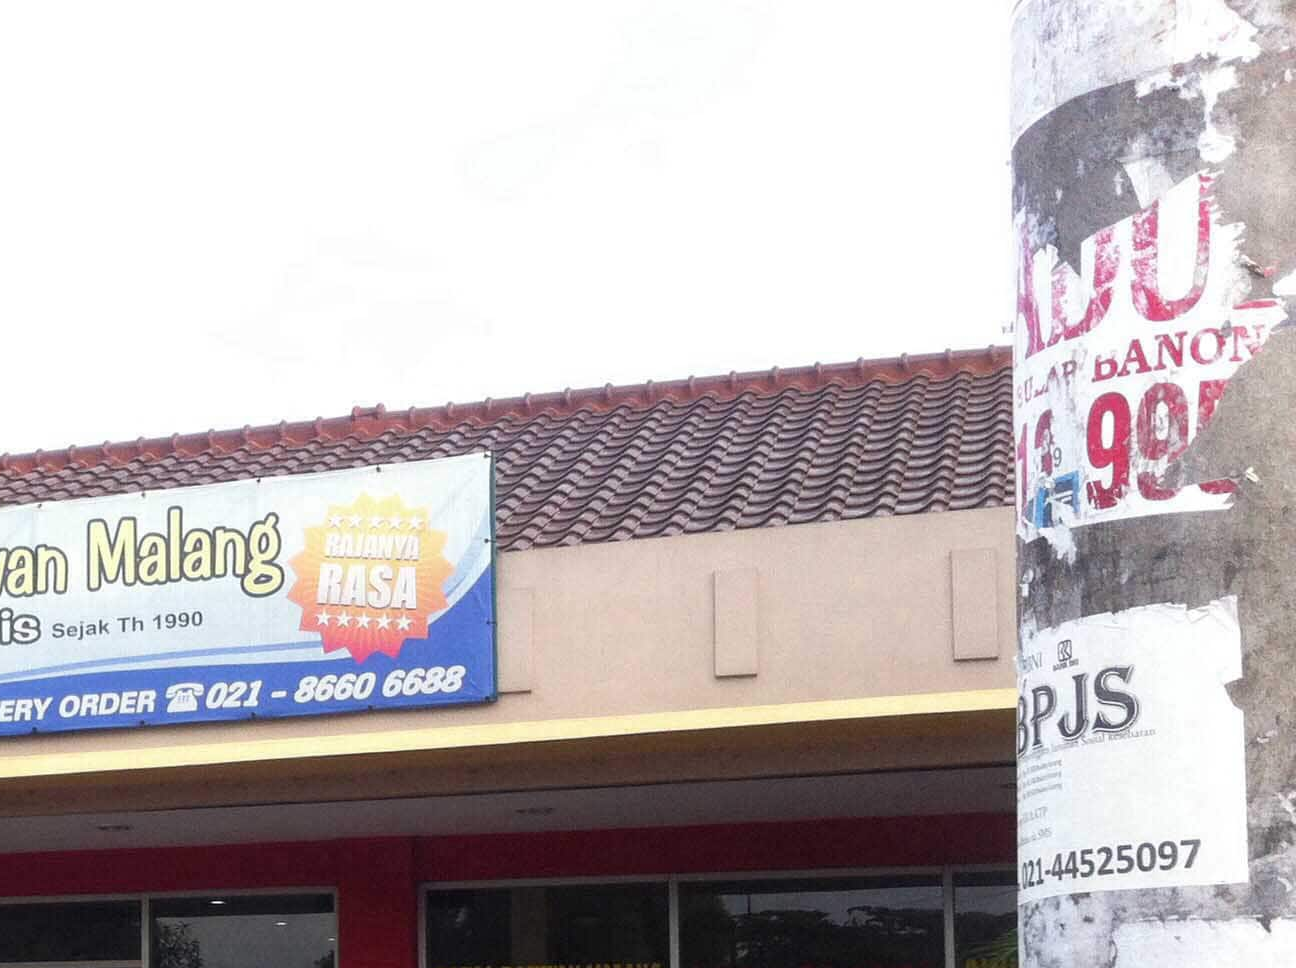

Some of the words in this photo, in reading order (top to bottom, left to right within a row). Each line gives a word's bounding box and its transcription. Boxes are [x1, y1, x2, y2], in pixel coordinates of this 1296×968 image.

[86, 505, 287, 598] Malang
[324, 532, 420, 563] RAJANYA
[315, 561, 419, 611] RASA
[51, 619, 110, 640] Sejak
[117, 615, 145, 635] Th
[152, 610, 203, 632] 1990
[58, 689, 157, 718] ORDER
[205, 679, 263, 710] 021
[294, 672, 376, 704] 8660
[381, 664, 466, 697] 6688
[1016, 664, 1142, 759] BPJS
[1021, 838, 1202, 890] 021-44525097
